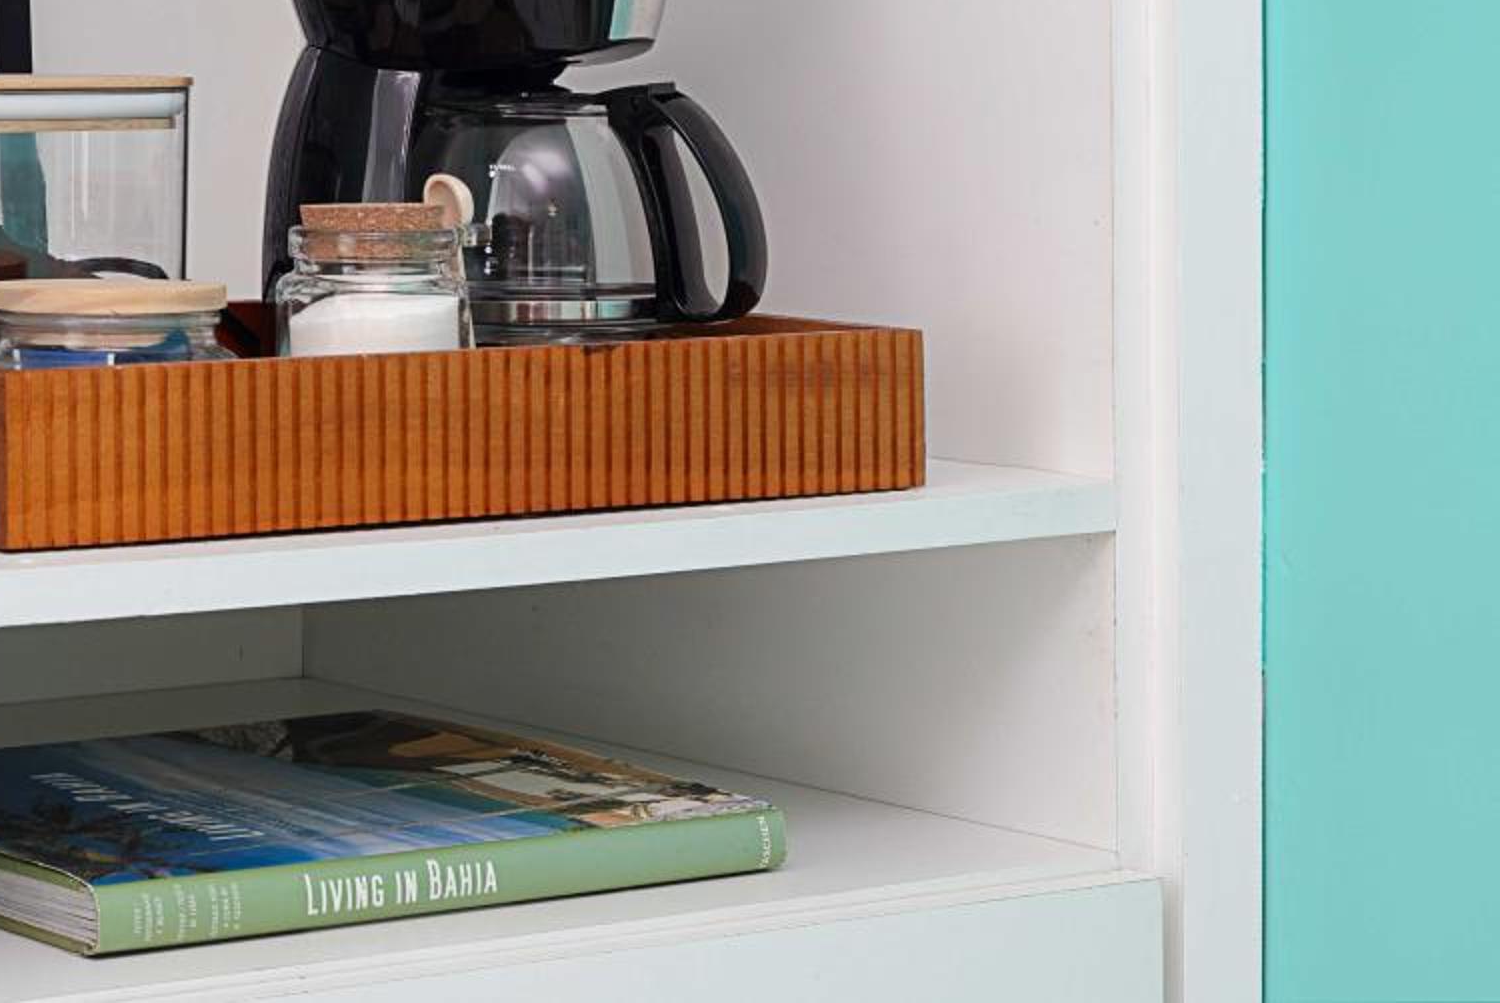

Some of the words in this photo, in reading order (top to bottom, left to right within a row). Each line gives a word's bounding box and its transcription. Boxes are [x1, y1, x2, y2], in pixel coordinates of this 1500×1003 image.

[303, 872, 386, 917] LIVING
[395, 869, 418, 905] IN
[426, 857, 498, 901] BAHIA
